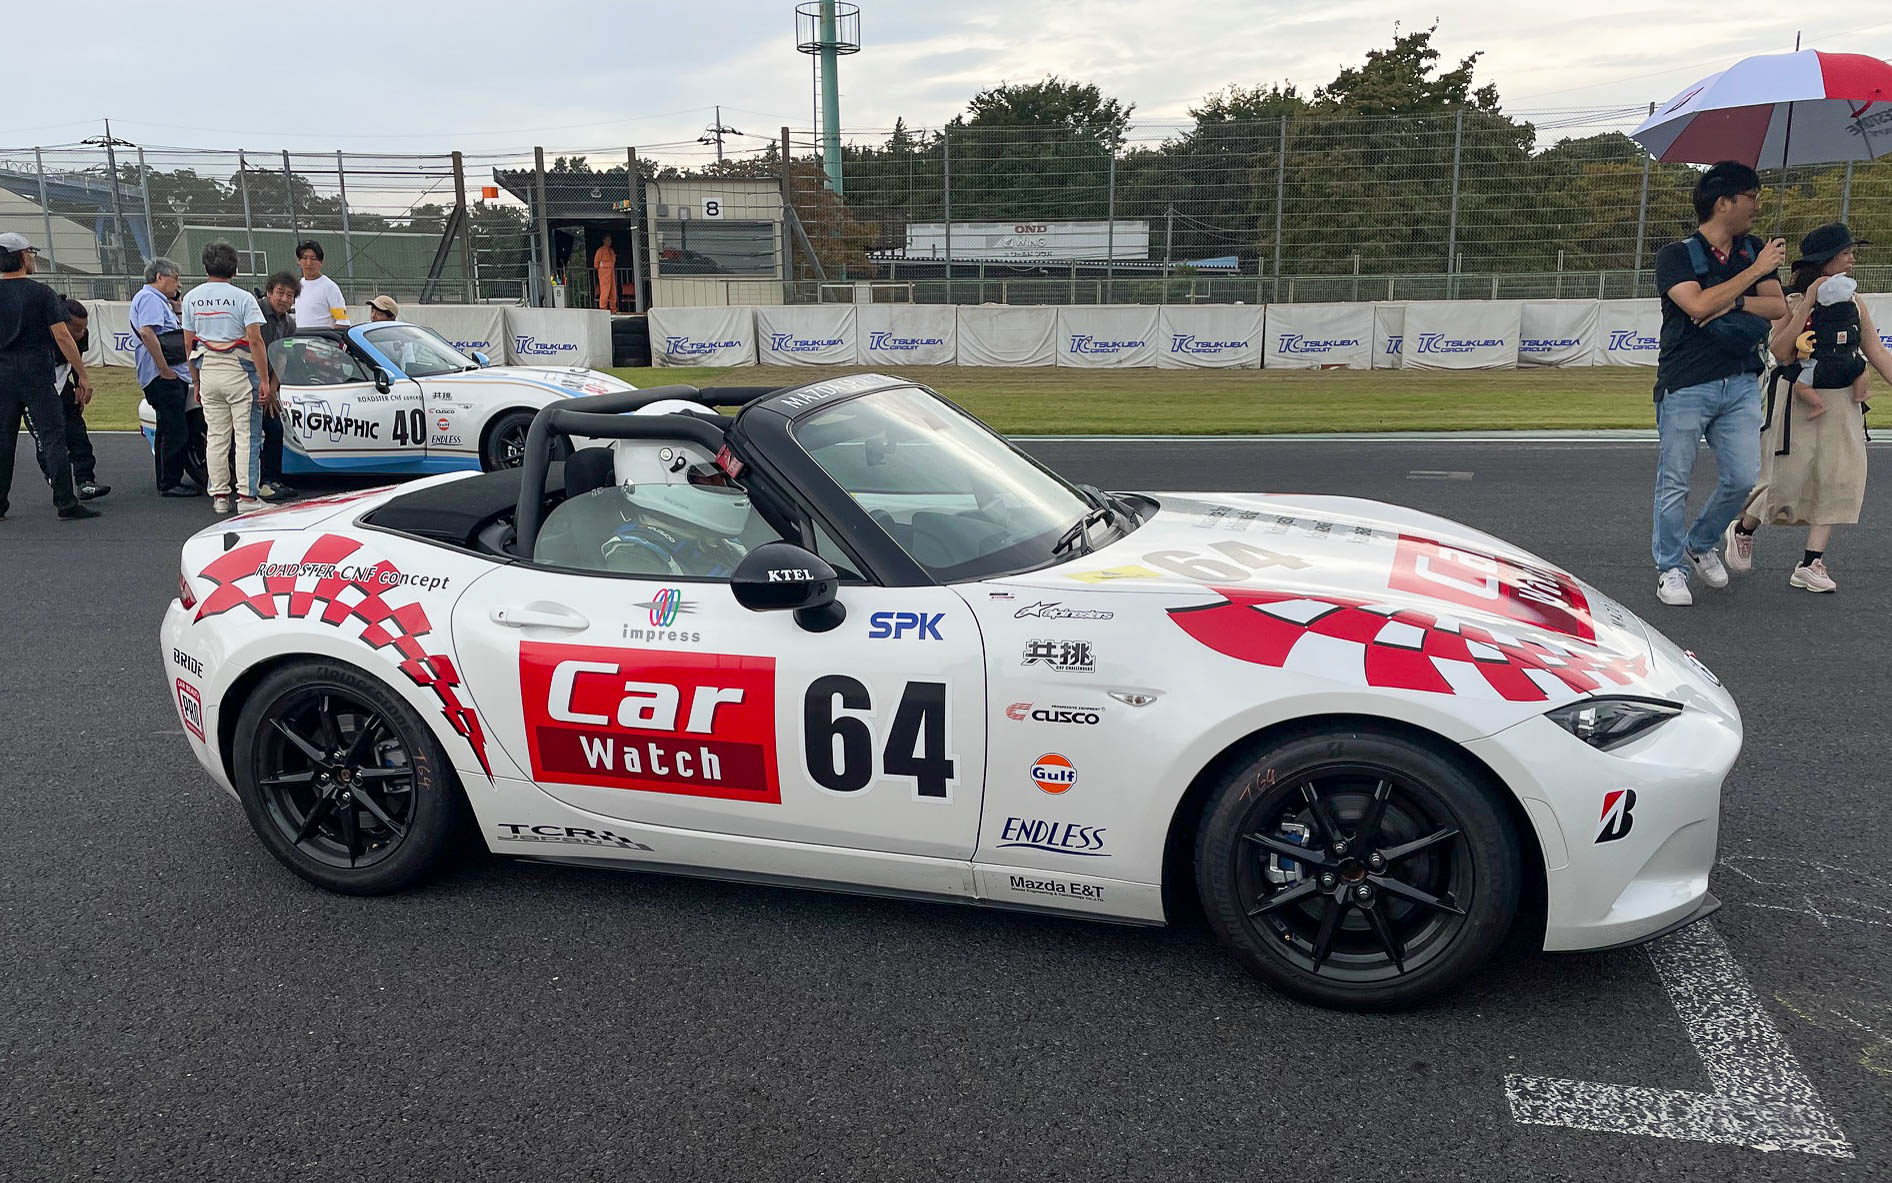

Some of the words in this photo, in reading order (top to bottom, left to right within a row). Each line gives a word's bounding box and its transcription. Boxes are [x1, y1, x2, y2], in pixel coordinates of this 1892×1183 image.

[706, 201, 719, 216] 8
[191, 299, 235, 307] YONTAI
[1303, 339, 1359, 347] TSUKUBA
[781, 382, 847, 408] MAZDA
[307, 412, 379, 439] GRAPHIC
[392, 408, 426, 446] 40
[431, 435, 461, 443] ENDLESS
[1142, 540, 1313, 582] 64
[256, 563, 335, 578] ROADSTER
[341, 565, 377, 583] CNF
[379, 570, 450, 591] concept
[767, 568, 814, 582] KTEL
[622, 623, 700, 643] impress
[868, 611, 946, 641] SPK
[173, 647, 203, 679] BRIDE
[547, 659, 744, 734] Car
[182, 694, 200, 727] PRO
[1032, 709, 1099, 725] CUSCO
[803, 673, 954, 799] 64
[580, 735, 722, 781] Watch
[1033, 767, 1075, 782] Gulf
[497, 823, 600, 840] TCR
[1000, 817, 1106, 850] ENDLESS
[1010, 876, 1066, 893] Mazda
[1070, 883, 1104, 898] E&T
